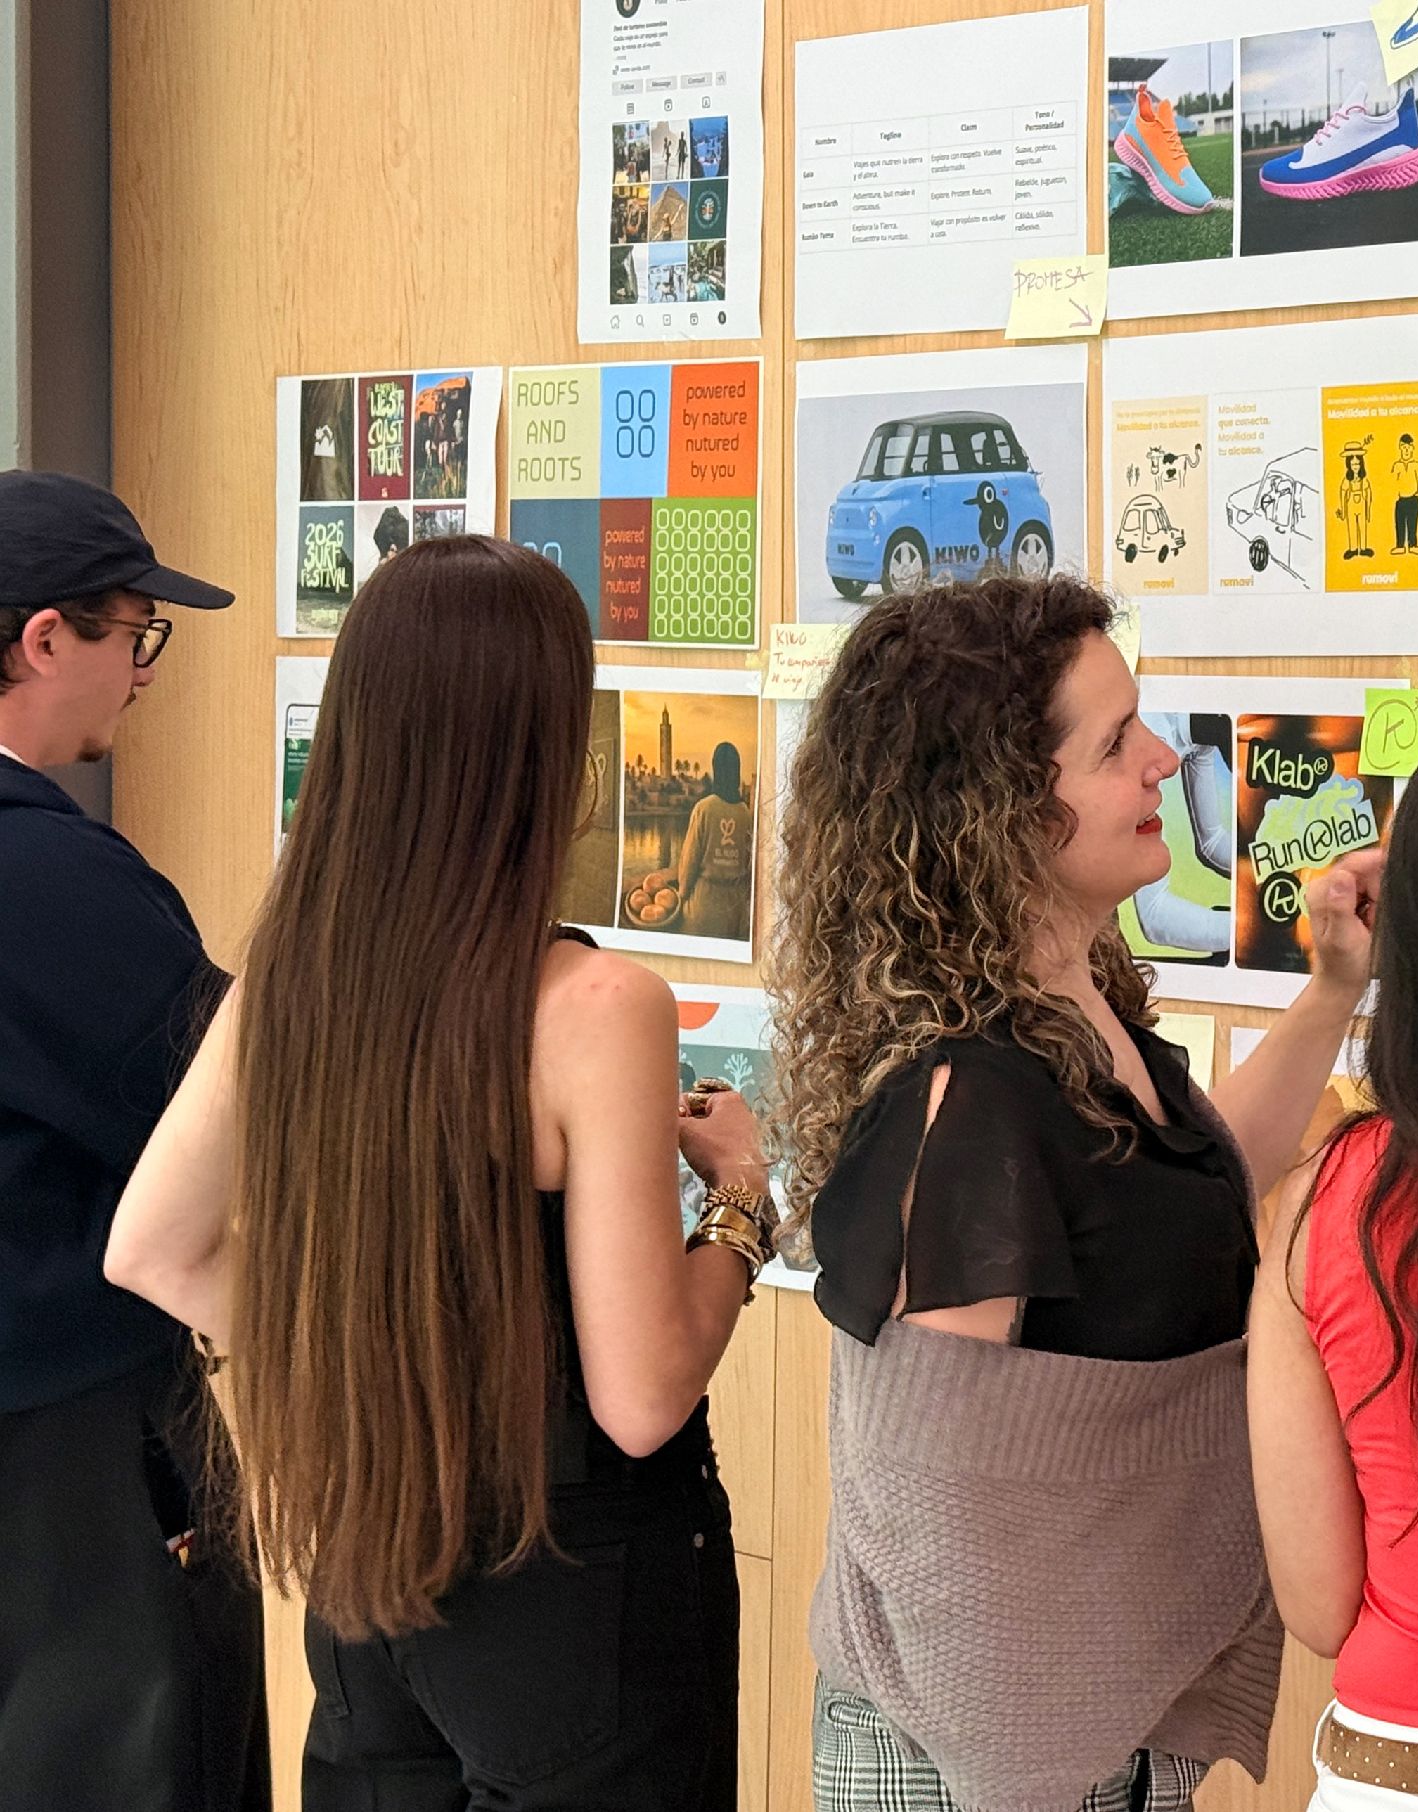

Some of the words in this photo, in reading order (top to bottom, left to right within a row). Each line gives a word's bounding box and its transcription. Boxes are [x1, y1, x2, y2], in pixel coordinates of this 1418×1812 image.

[1014, 266, 1095, 298] PROMESA
[516, 380, 580, 407] ROOFS
[686, 380, 747, 404] powered
[682, 408, 699, 430] by
[702, 409, 748, 426] nature
[1218, 404, 1257, 415] Movilidad
[1327, 407, 1370, 419] Movilidad
[526, 418, 567, 445] AND
[1218, 418, 1234, 430] que
[1235, 416, 1271, 426] conecta.
[685, 434, 741, 452] nutured
[1218, 431, 1257, 442] Movilidad
[1228, 446, 1264, 456] alcance.
[517, 456, 583, 483] ROOTS
[690, 461, 708, 481] by
[710, 463, 736, 482] you
[304, 520, 344, 547] 2026
[604, 526, 646, 546] powered
[303, 544, 342, 571] SURF
[603, 553, 618, 571] by
[618, 554, 647, 569] nature
[300, 567, 350, 593] FESTIVAL
[605, 578, 642, 595] nutured
[610, 602, 623, 620] by
[622, 606, 640, 623] you
